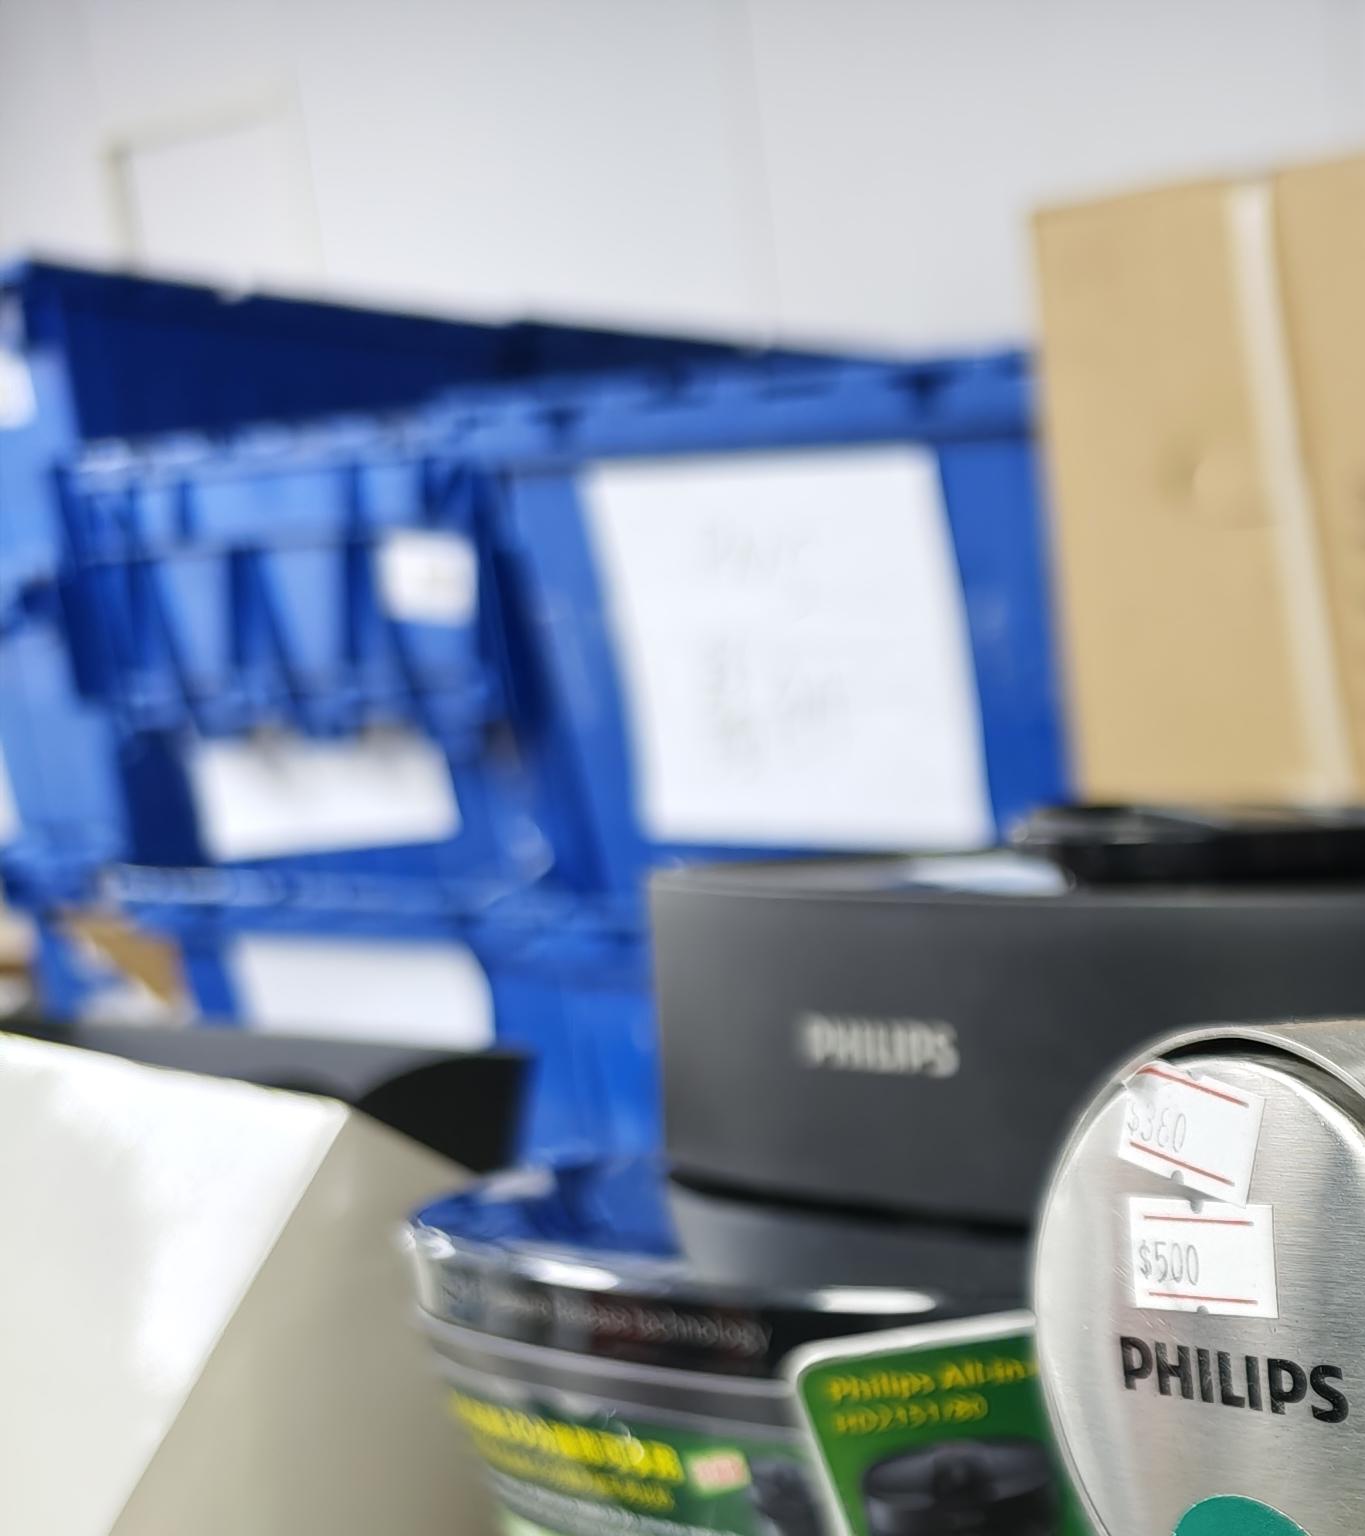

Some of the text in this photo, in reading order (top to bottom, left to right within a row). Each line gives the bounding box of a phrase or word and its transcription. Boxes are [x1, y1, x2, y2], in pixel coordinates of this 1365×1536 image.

[803, 1012, 960, 1079] PHILIPS
[1139, 1239, 1200, 1286] $500
[828, 1371, 936, 1402] Philips
[1119, 1335, 1350, 1424] PHILIPS
